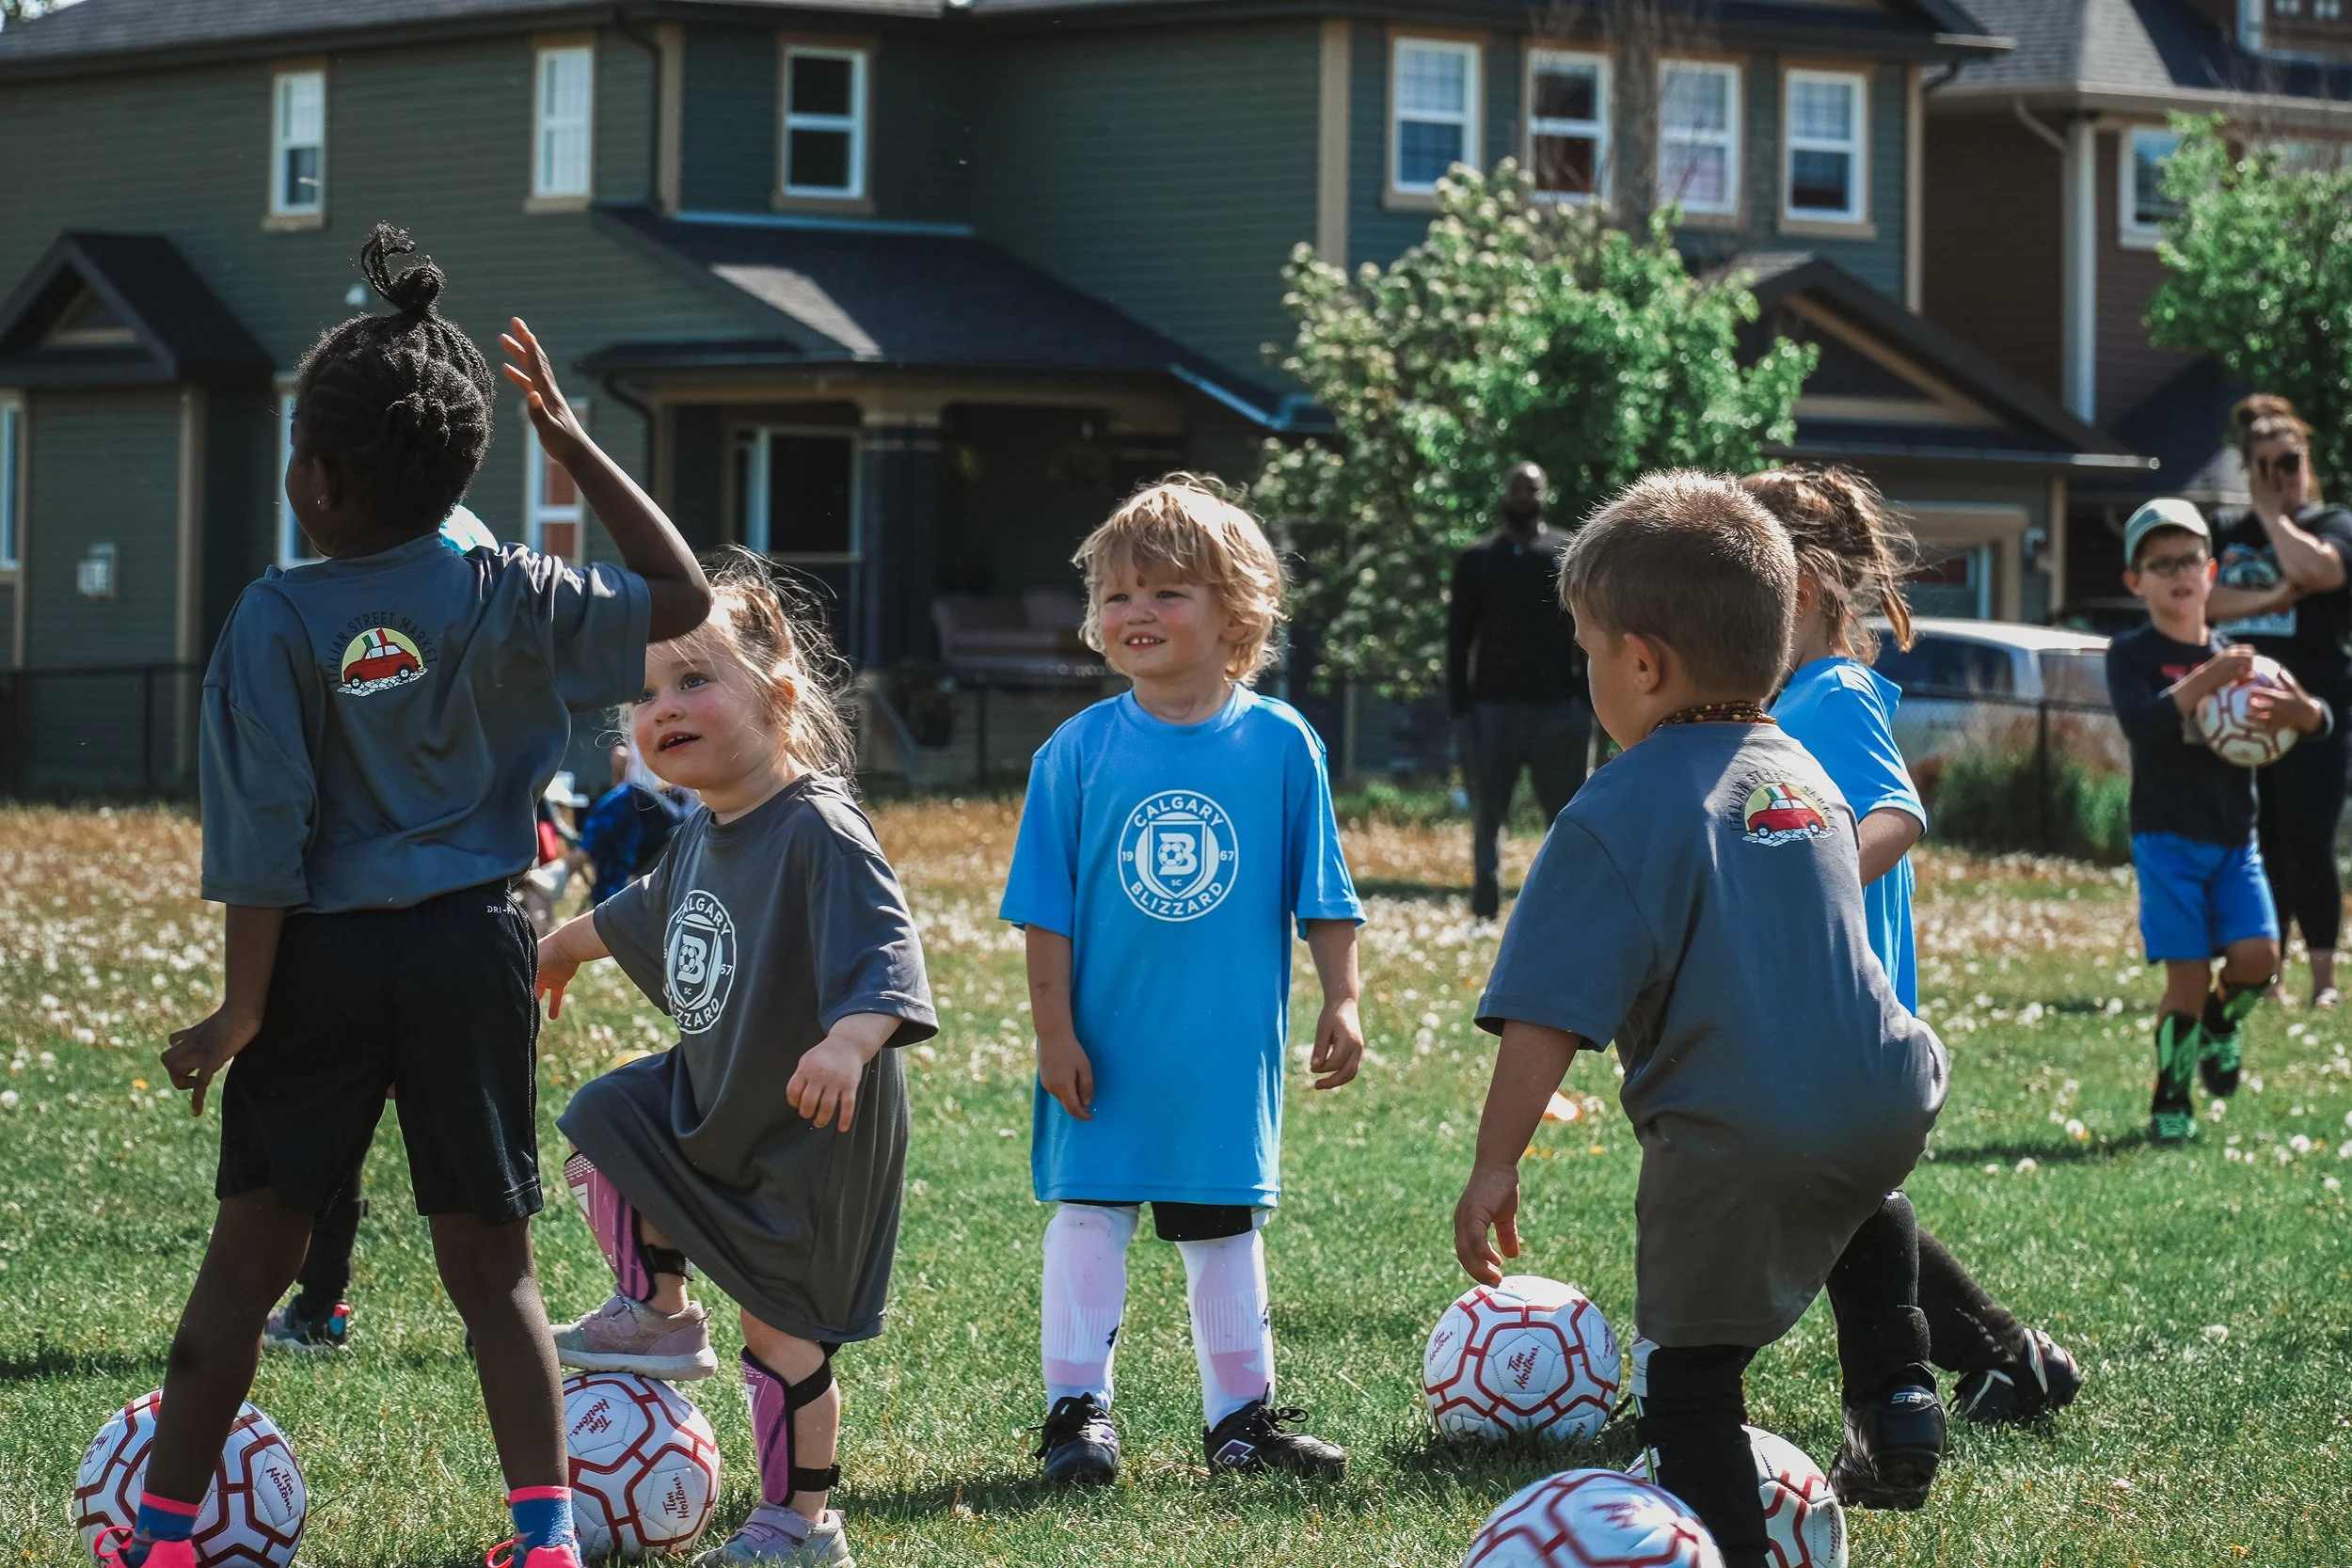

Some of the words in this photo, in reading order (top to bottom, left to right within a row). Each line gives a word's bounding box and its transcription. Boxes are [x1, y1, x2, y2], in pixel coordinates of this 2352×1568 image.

[326, 632, 349, 684] ITALIAN
[347, 611, 395, 634] STREET
[399, 617, 438, 664] MARKET
[1134, 796, 1224, 828] CALGARY
[1728, 782, 1752, 831] ITALIAN
[1121, 850, 1134, 862] 19
[1219, 850, 1234, 862] 67
[1130, 880, 1223, 915] BLIZZARD
[675, 897, 731, 936] CALGARY
[720, 963, 734, 976] 67
[1507, 1352, 1525, 1372] Tim
[588, 1414, 612, 1434] Tim
[282, 1468, 294, 1497] Tim
[661, 1491, 677, 1515] Tim
